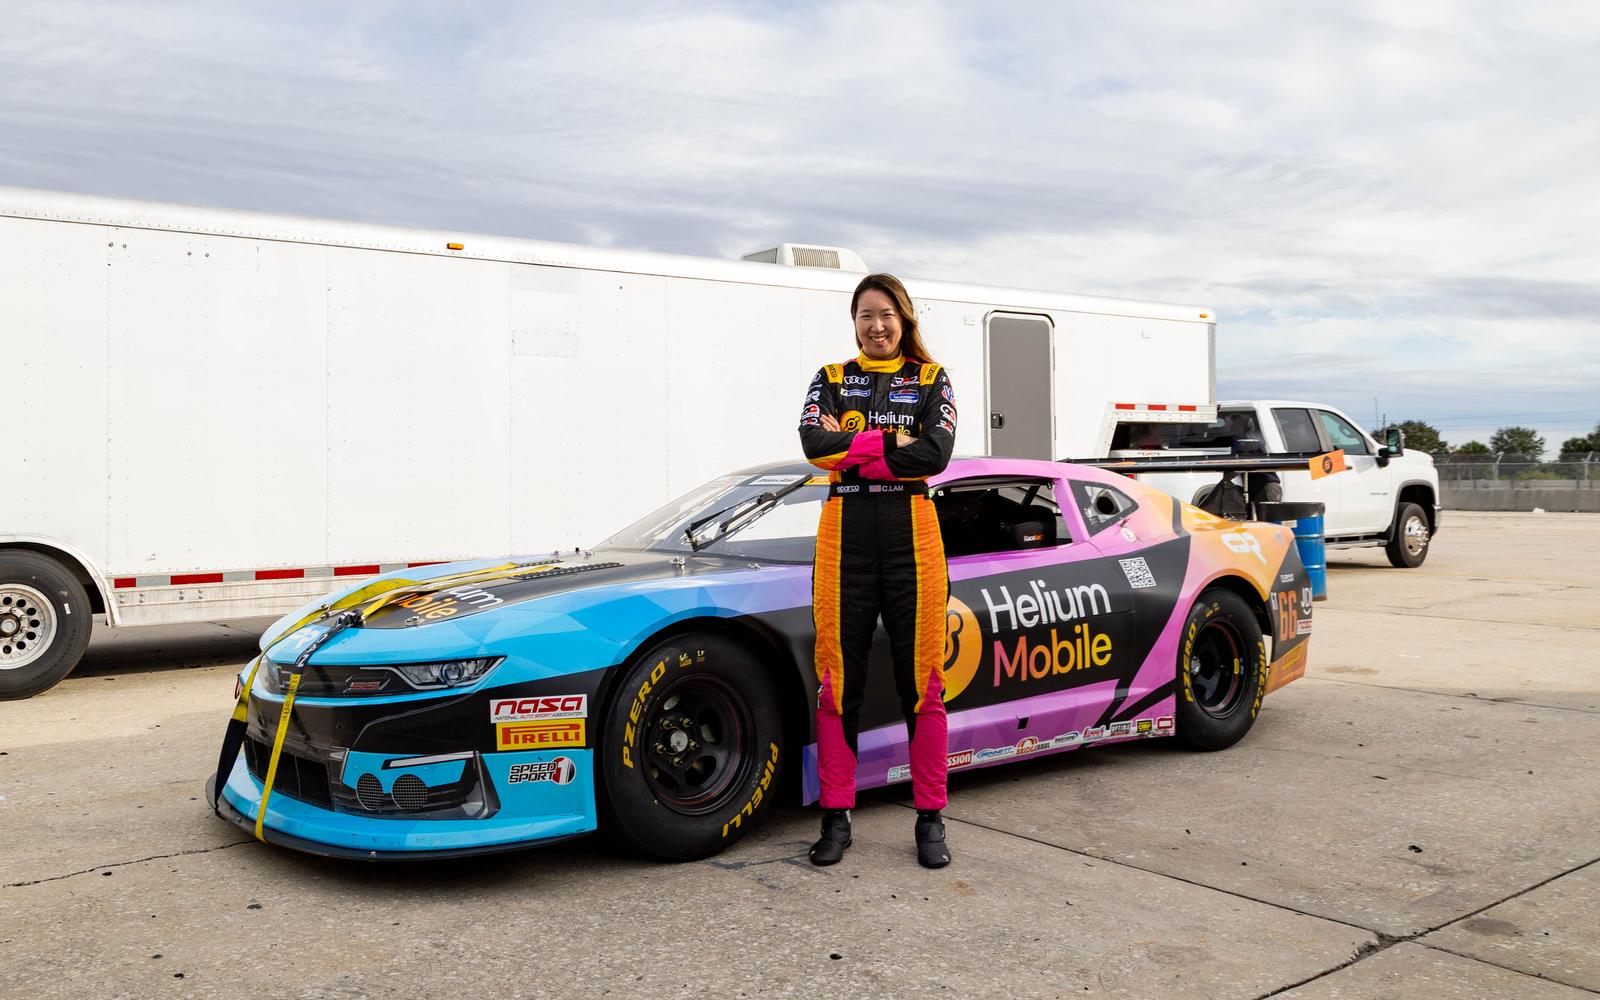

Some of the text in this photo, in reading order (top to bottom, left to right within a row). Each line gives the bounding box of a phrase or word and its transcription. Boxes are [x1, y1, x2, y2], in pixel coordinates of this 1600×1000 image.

[869, 411, 914, 426] Helium
[836, 485, 859, 493] sparco
[981, 579, 1112, 634] Helium
[1279, 590, 1297, 641] 66
[993, 622, 1113, 687] Mobile
[502, 723, 581, 745] PIRELLI
[508, 771, 554, 783] SPORT
[510, 762, 557, 774] SPEED
[722, 742, 779, 837] PIRELLI
